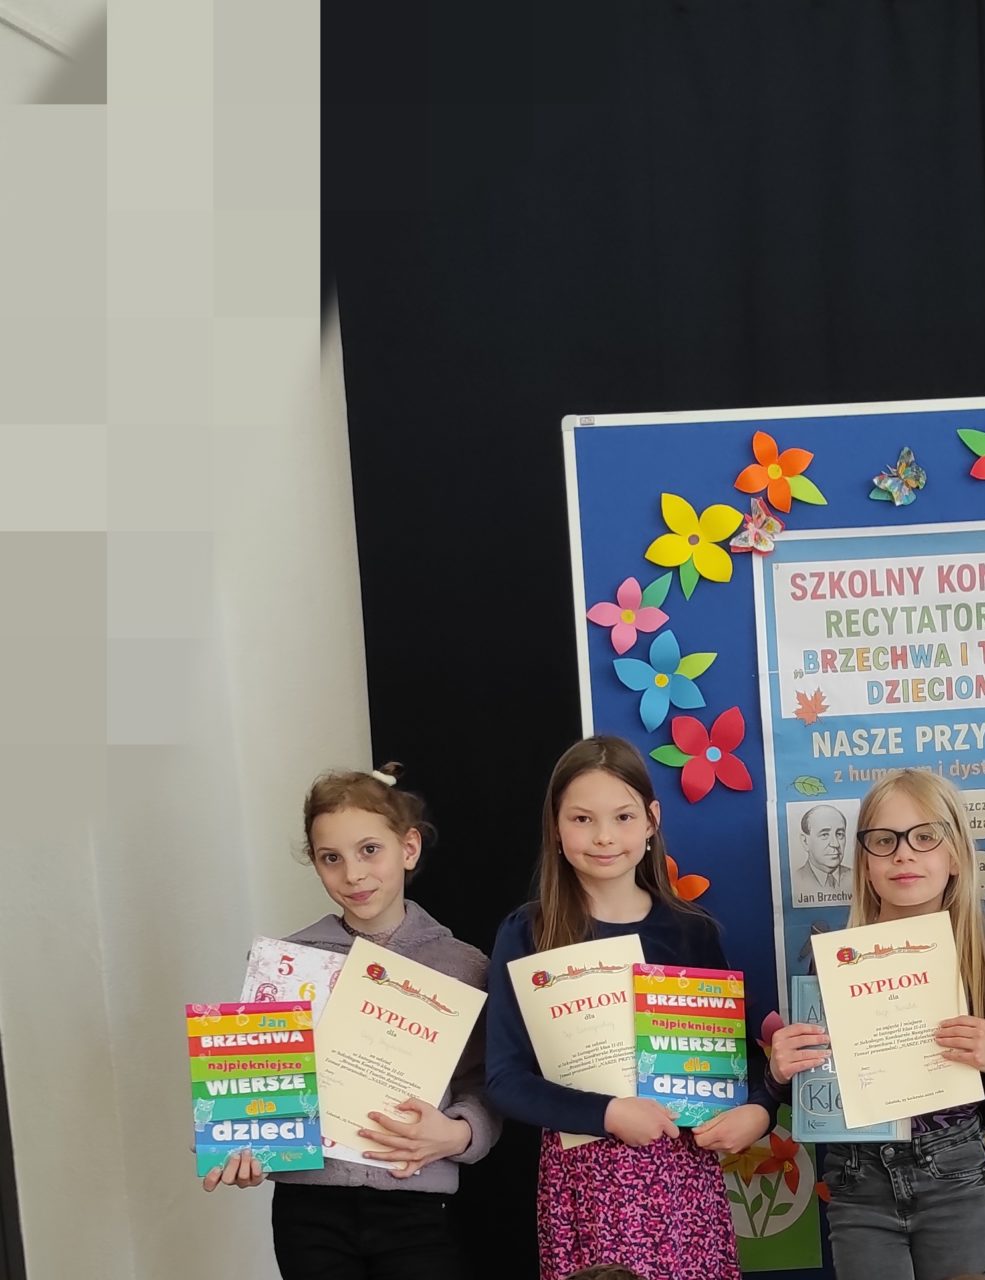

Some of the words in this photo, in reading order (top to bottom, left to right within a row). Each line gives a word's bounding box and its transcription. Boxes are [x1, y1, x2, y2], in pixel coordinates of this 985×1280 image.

[790, 566, 925, 601] SZKOLNY
[960, 642, 969, 667] I
[812, 727, 904, 758] NASZE
[834, 769, 843, 783] z
[798, 892, 815, 904] Jan
[817, 891, 853, 902] Brzechw
[278, 955, 295, 976] 5
[299, 982, 316, 1002] 6
[697, 983, 722, 994] Jan
[849, 971, 929, 998] DYPLOM
[549, 990, 629, 1019] DYPLOM
[646, 993, 737, 1009] BRZECHWA
[888, 993, 899, 1001] dla
[258, 1015, 288, 1029] Jan
[359, 999, 440, 1045] DYPLOM
[651, 1018, 735, 1034] najpiękniejsze
[200, 1031, 305, 1049] BRZECHWA
[649, 1036, 737, 1053] WIERSZE
[683, 1058, 711, 1072] dla
[205, 1074, 306, 1097] WIERSZE
[653, 1075, 735, 1099] dzieci
[245, 1099, 276, 1115] dla
[211, 1119, 305, 1142] dzieci
